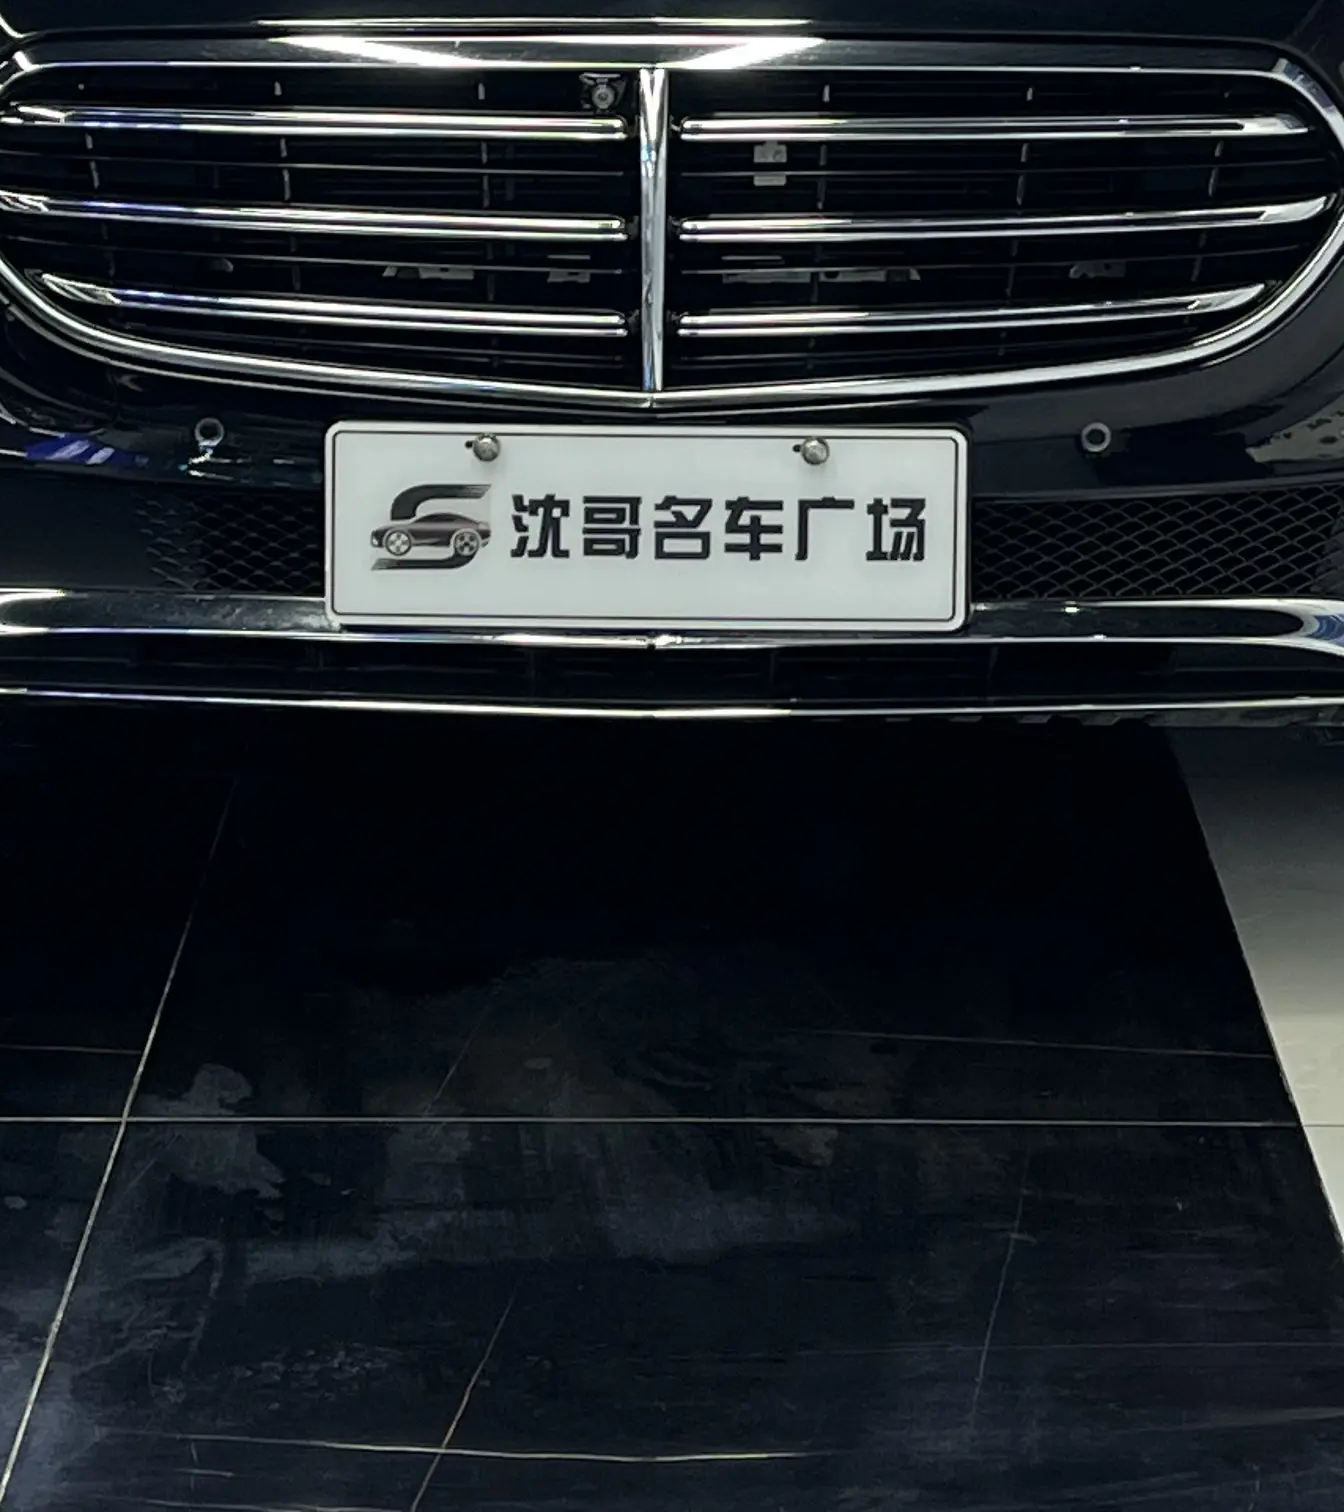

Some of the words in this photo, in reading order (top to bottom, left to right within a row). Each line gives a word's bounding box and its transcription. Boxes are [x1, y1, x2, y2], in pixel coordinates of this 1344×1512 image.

[510, 493, 927, 561] 沈哥名车广场
